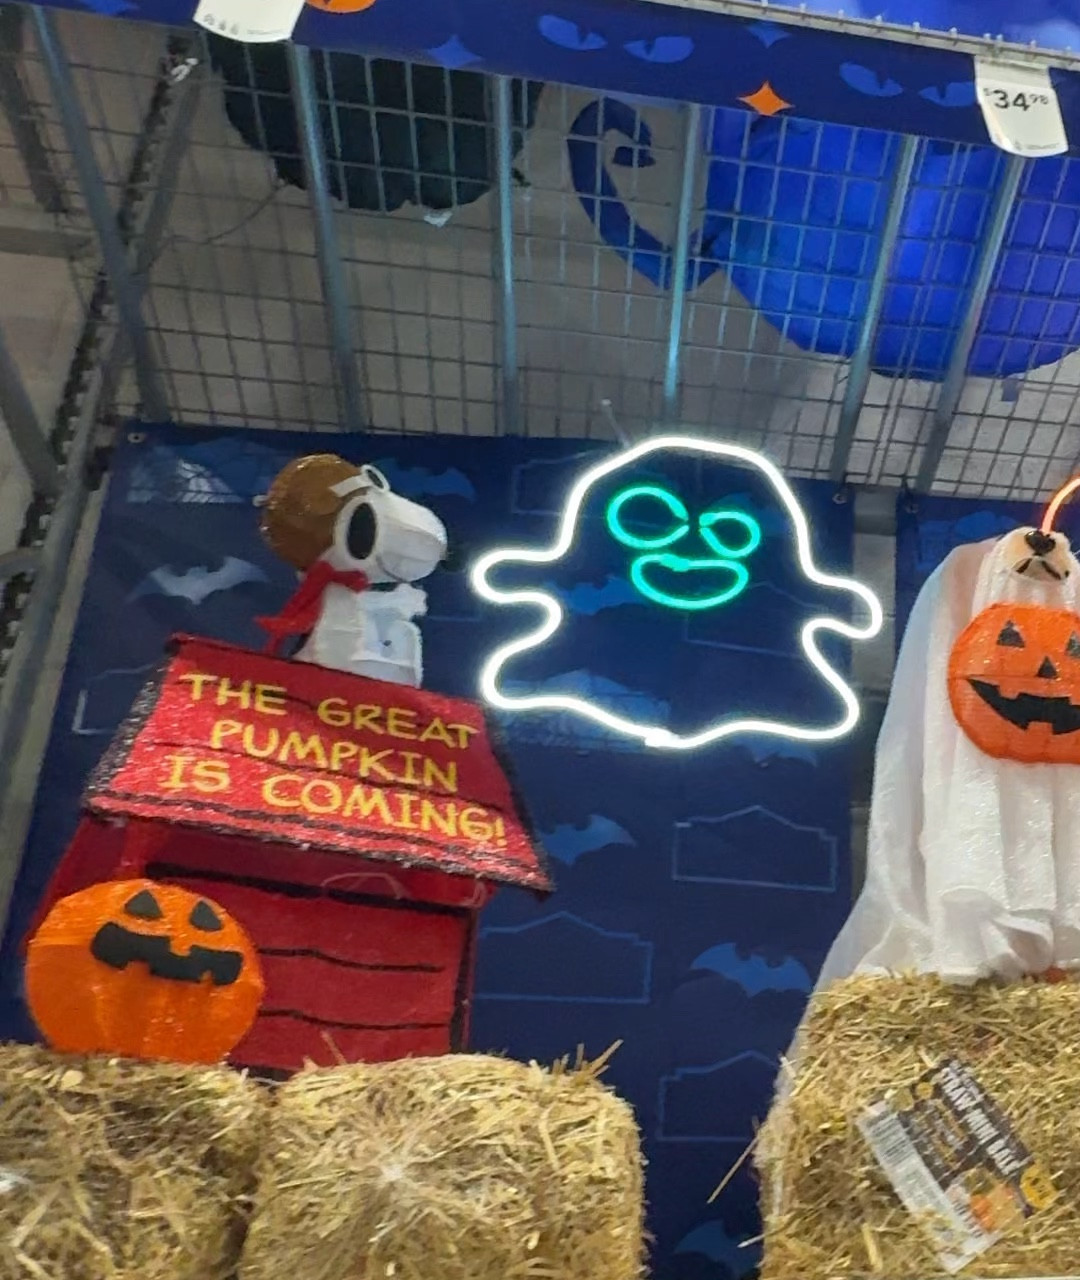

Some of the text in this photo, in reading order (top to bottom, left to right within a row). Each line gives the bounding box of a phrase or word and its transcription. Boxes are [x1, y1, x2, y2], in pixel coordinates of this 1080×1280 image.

[179, 673, 480, 750] THE GREAT
[210, 719, 458, 794] PUMPKIN
[160, 755, 507, 848] IS COMING!
